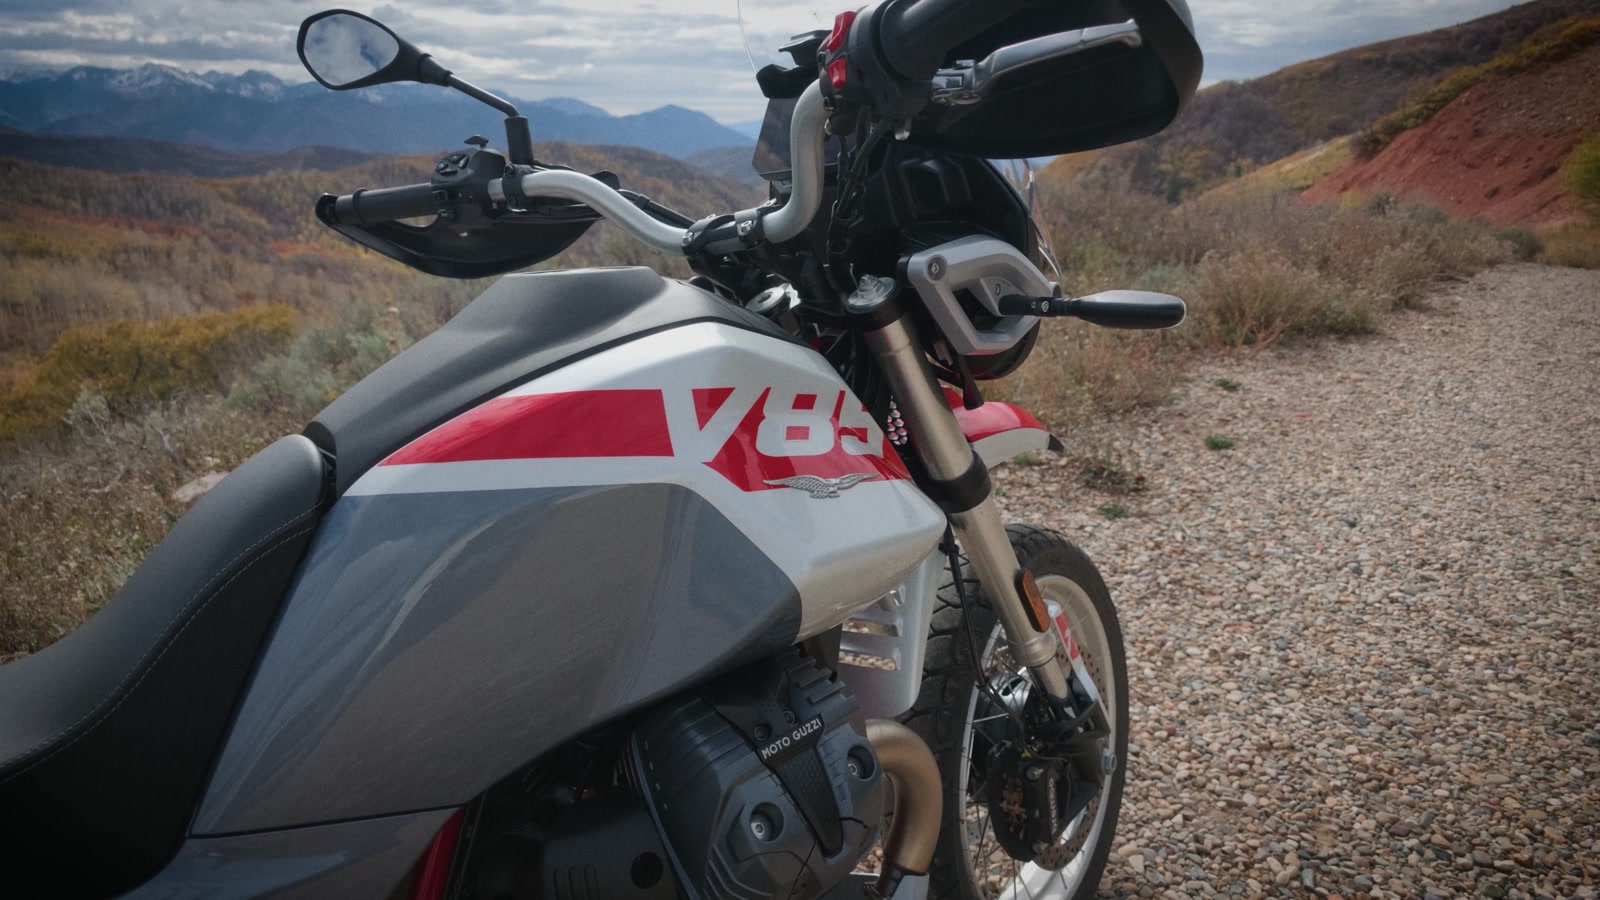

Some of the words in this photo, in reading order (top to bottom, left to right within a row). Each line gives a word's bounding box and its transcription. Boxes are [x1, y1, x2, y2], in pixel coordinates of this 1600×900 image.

[661, 386, 884, 463] V85
[762, 737, 791, 759] MOTO
[792, 718, 822, 740] GUZZI
[1049, 777, 1057, 835] brembo
